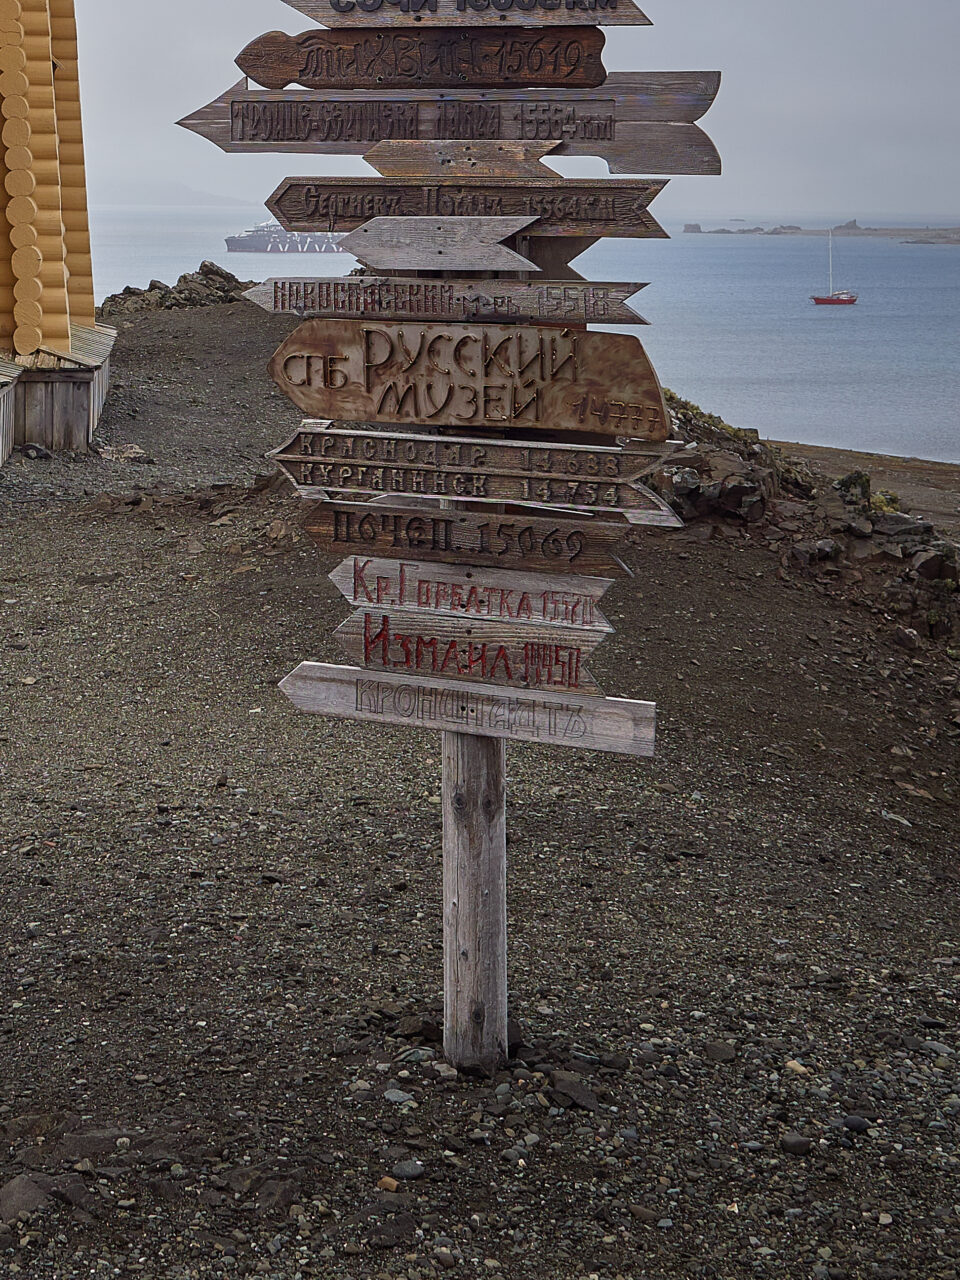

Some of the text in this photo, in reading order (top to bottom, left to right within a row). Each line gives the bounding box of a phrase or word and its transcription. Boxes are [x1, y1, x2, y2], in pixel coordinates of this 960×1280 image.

[282, 327, 580, 393] СПБ РУССКИЙ
[377, 378, 661, 432] МУЗЕЙ 14777
[300, 434, 487, 468] КРАСНОДАР
[477, 521, 587, 563] 15069
